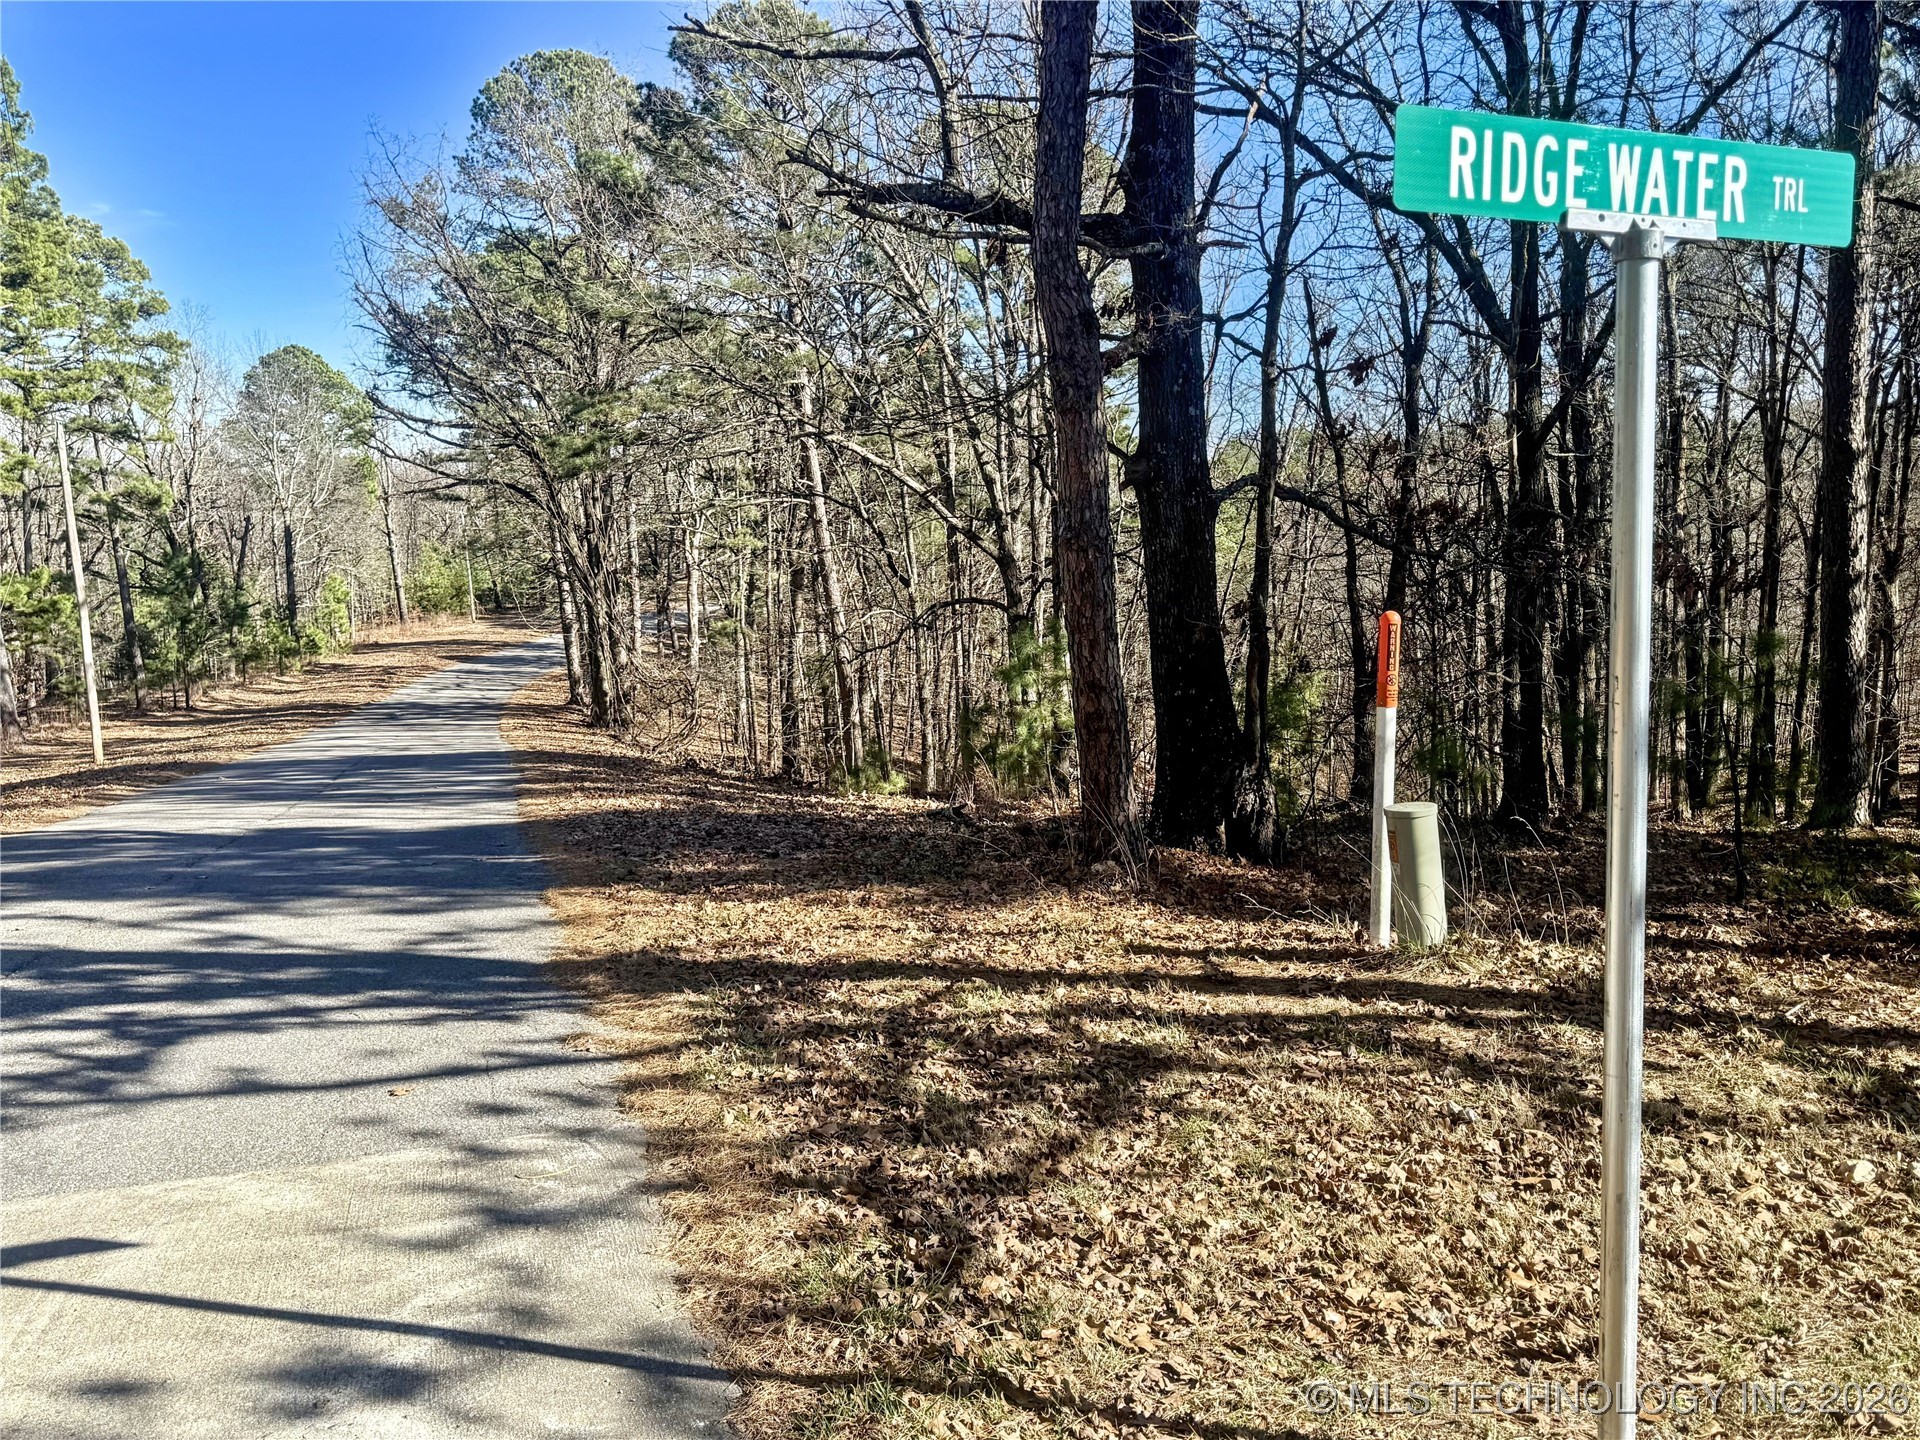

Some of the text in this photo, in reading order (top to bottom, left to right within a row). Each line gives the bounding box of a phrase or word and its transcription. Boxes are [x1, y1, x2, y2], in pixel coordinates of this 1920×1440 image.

[1449, 126, 1809, 223] RIDGE WATER TRL
[1388, 624, 1397, 671] WARNING
